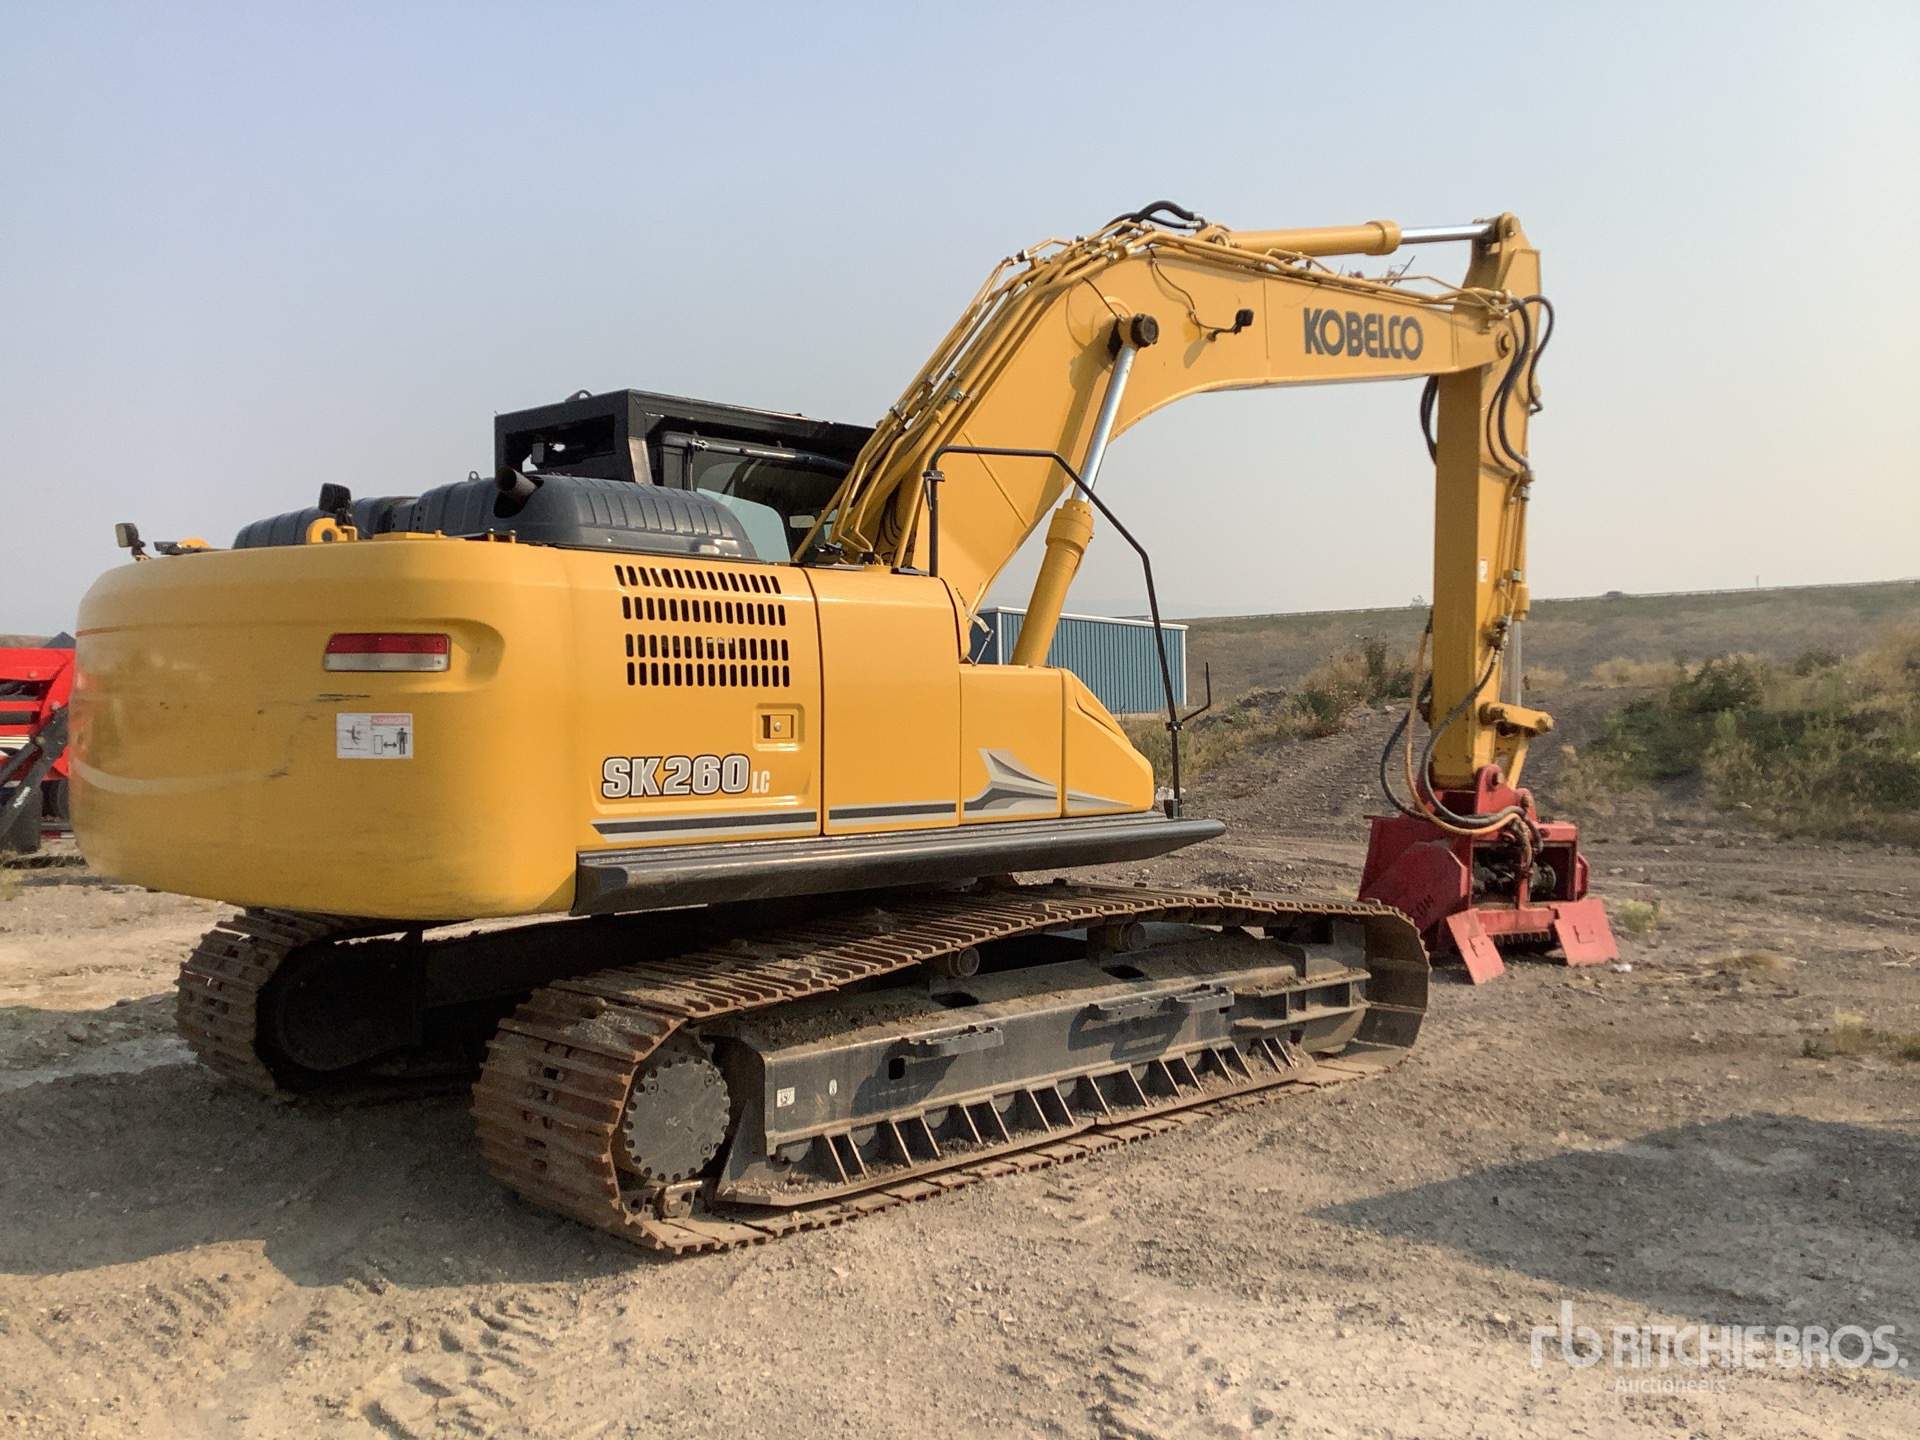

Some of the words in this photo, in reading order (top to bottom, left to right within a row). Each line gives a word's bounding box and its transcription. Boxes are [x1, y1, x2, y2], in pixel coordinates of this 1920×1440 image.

[1303, 307, 1424, 361] KOBELCO
[601, 753, 750, 798] SK260
[751, 770, 771, 794] LC
